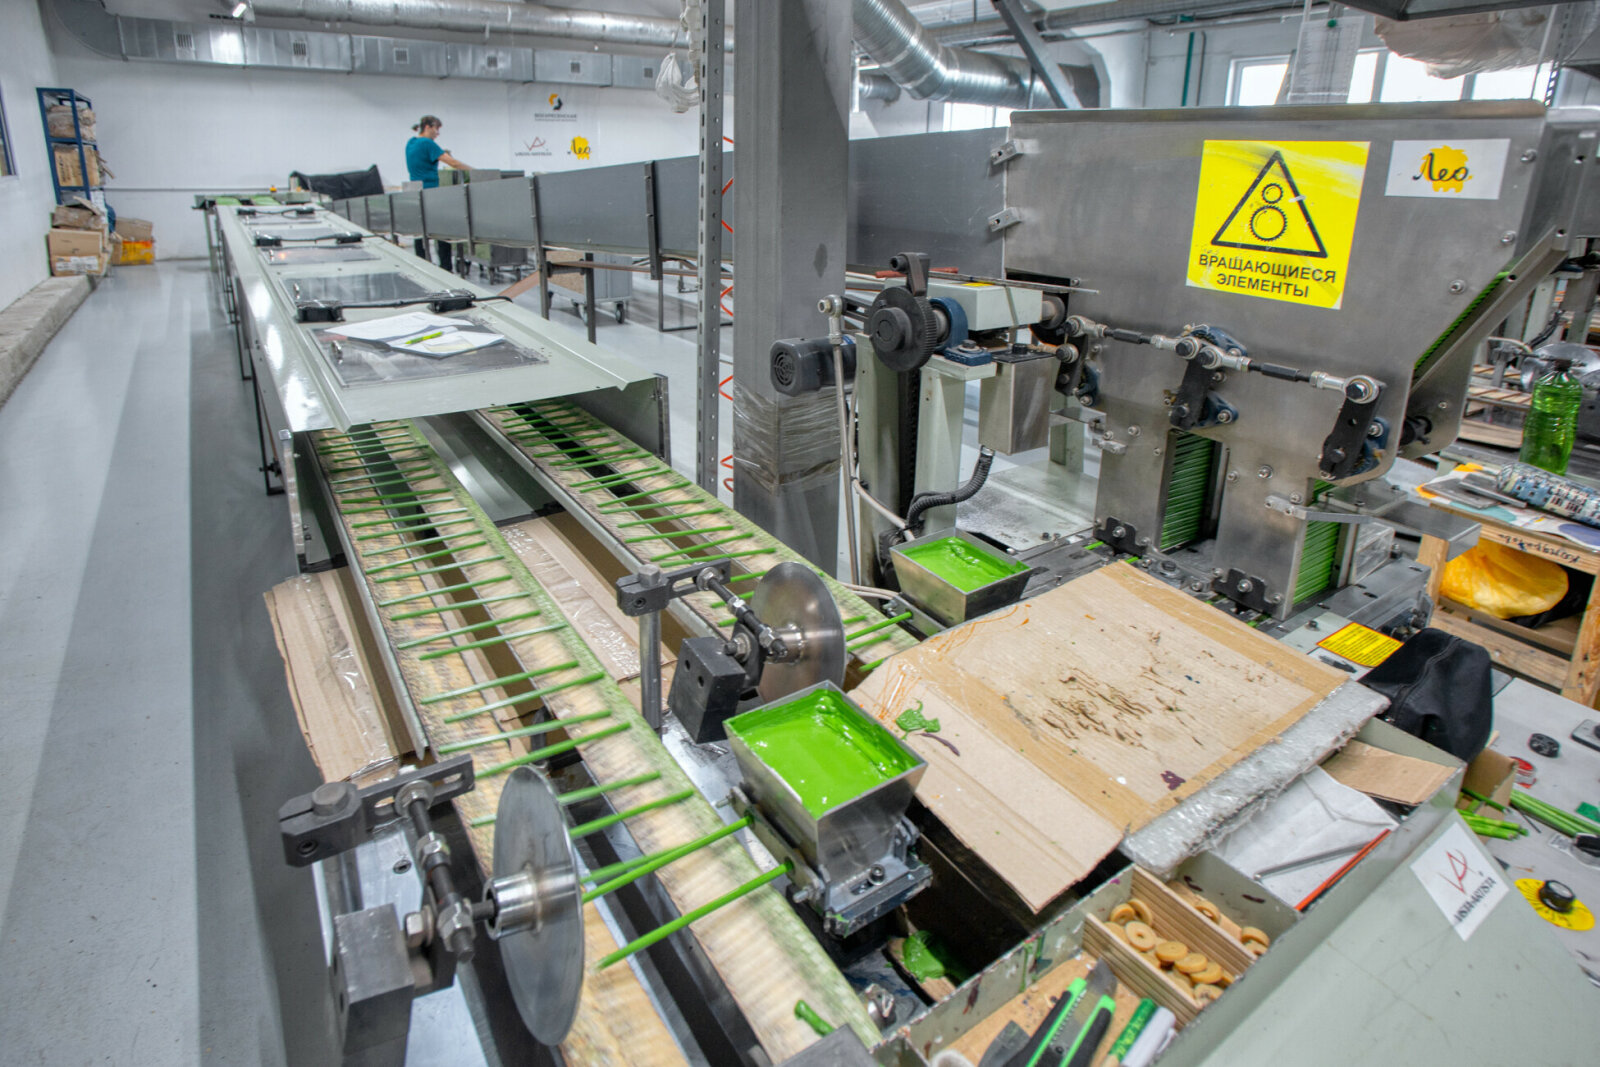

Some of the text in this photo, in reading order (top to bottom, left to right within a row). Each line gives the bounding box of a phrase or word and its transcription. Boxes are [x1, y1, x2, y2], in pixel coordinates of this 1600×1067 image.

[1412, 152, 1469, 182] Лео
[1199, 253, 1337, 284] ВРАЩАЮЩИЕСЯ
[1216, 273, 1310, 298] ЭЛЕМЕНТЫ
